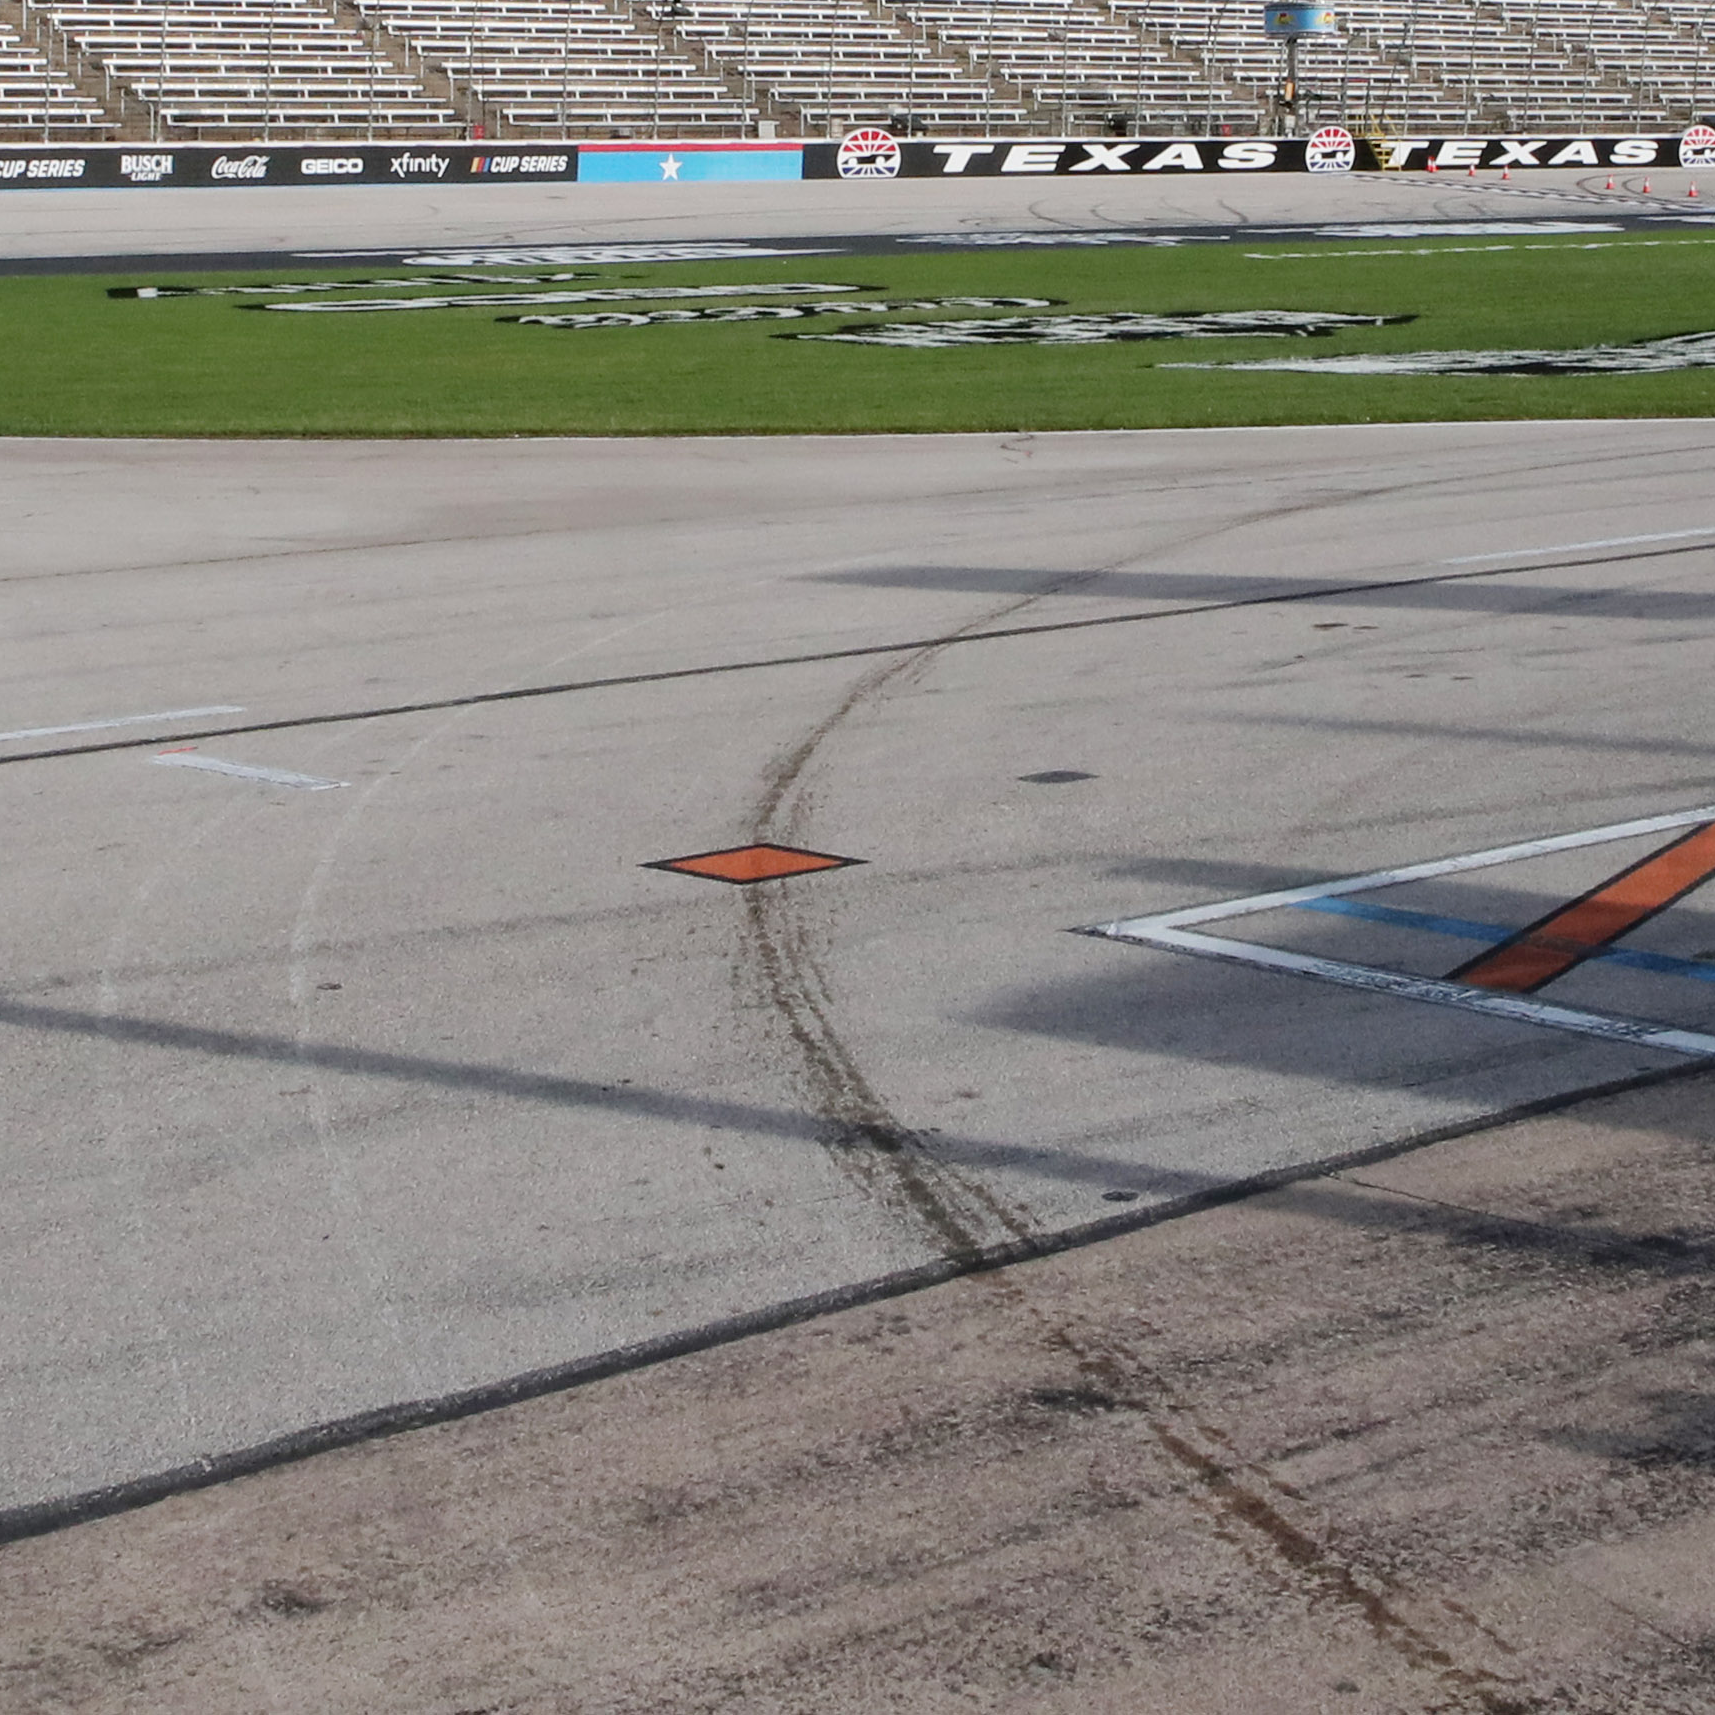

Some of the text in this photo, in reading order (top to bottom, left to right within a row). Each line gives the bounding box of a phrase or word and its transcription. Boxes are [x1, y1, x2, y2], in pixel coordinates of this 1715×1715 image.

[932, 142, 1278, 173] TEXAS
[1383, 139, 1659, 166] TEXAS
[27, 159, 85, 178] SERIES
[120, 155, 173, 174] BUSCH
[301, 158, 363, 174] GEICO
[390, 152, 449, 178] xfinity
[490, 155, 568, 173] CUP SERIES
[130, 172, 162, 181] LIGHT
